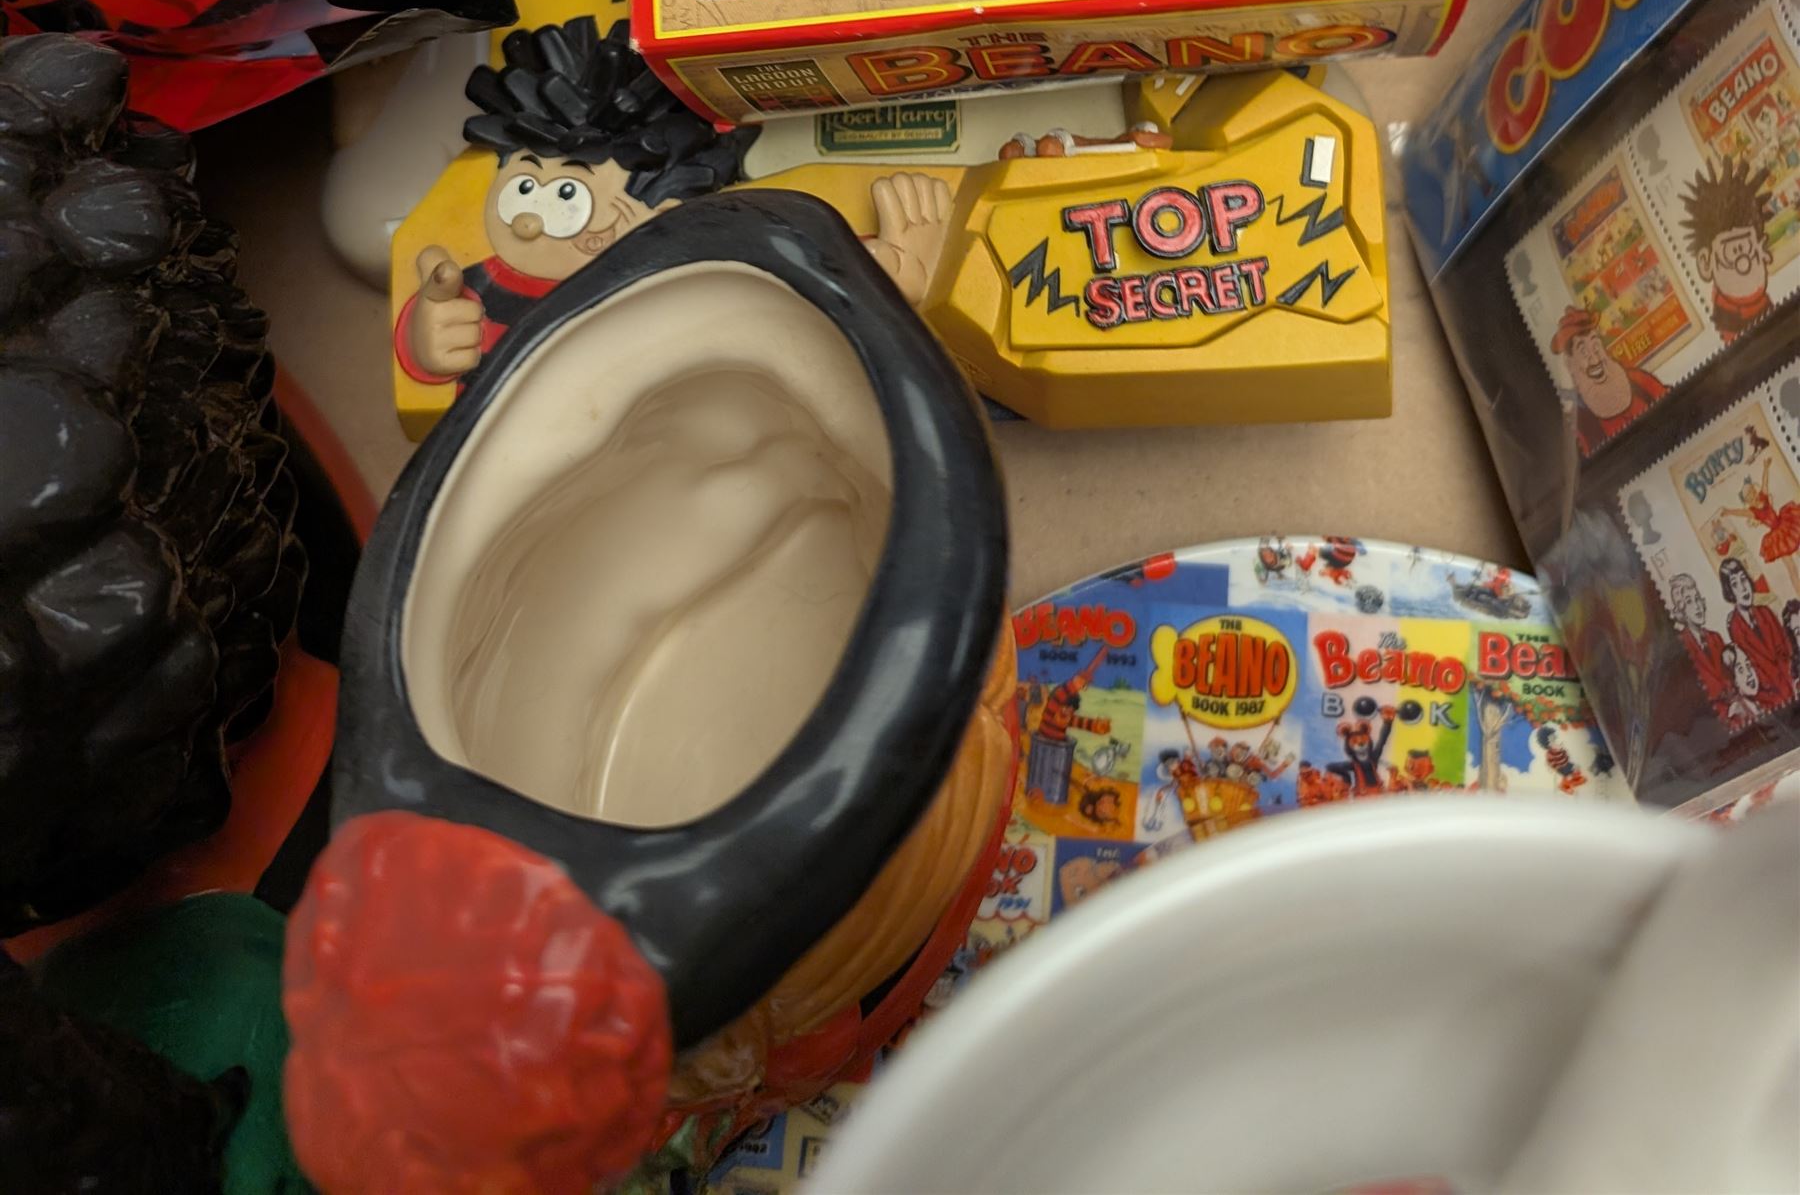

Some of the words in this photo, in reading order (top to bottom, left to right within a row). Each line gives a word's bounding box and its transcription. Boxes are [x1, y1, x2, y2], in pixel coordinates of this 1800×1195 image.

[846, 23, 1398, 96] BEANO
[957, 31, 1048, 47] THE
[732, 67, 816, 85] LAGOON
[739, 76, 820, 93] GROUP
[755, 63, 783, 73] THE
[1707, 50, 1780, 124] BEANO
[1061, 179, 1266, 274] TOP
[1085, 256, 1270, 331] SECRET
[1012, 603, 1137, 649] BEANO
[1376, 631, 1408, 650] The
[1172, 632, 1291, 699] BEANO
[1313, 629, 1467, 694] Beano
[1478, 630, 1579, 681] Bea
[1191, 696, 1230, 717] BOOK
[1234, 698, 1266, 717] 1987
[1521, 682, 1566, 697] BOOK
